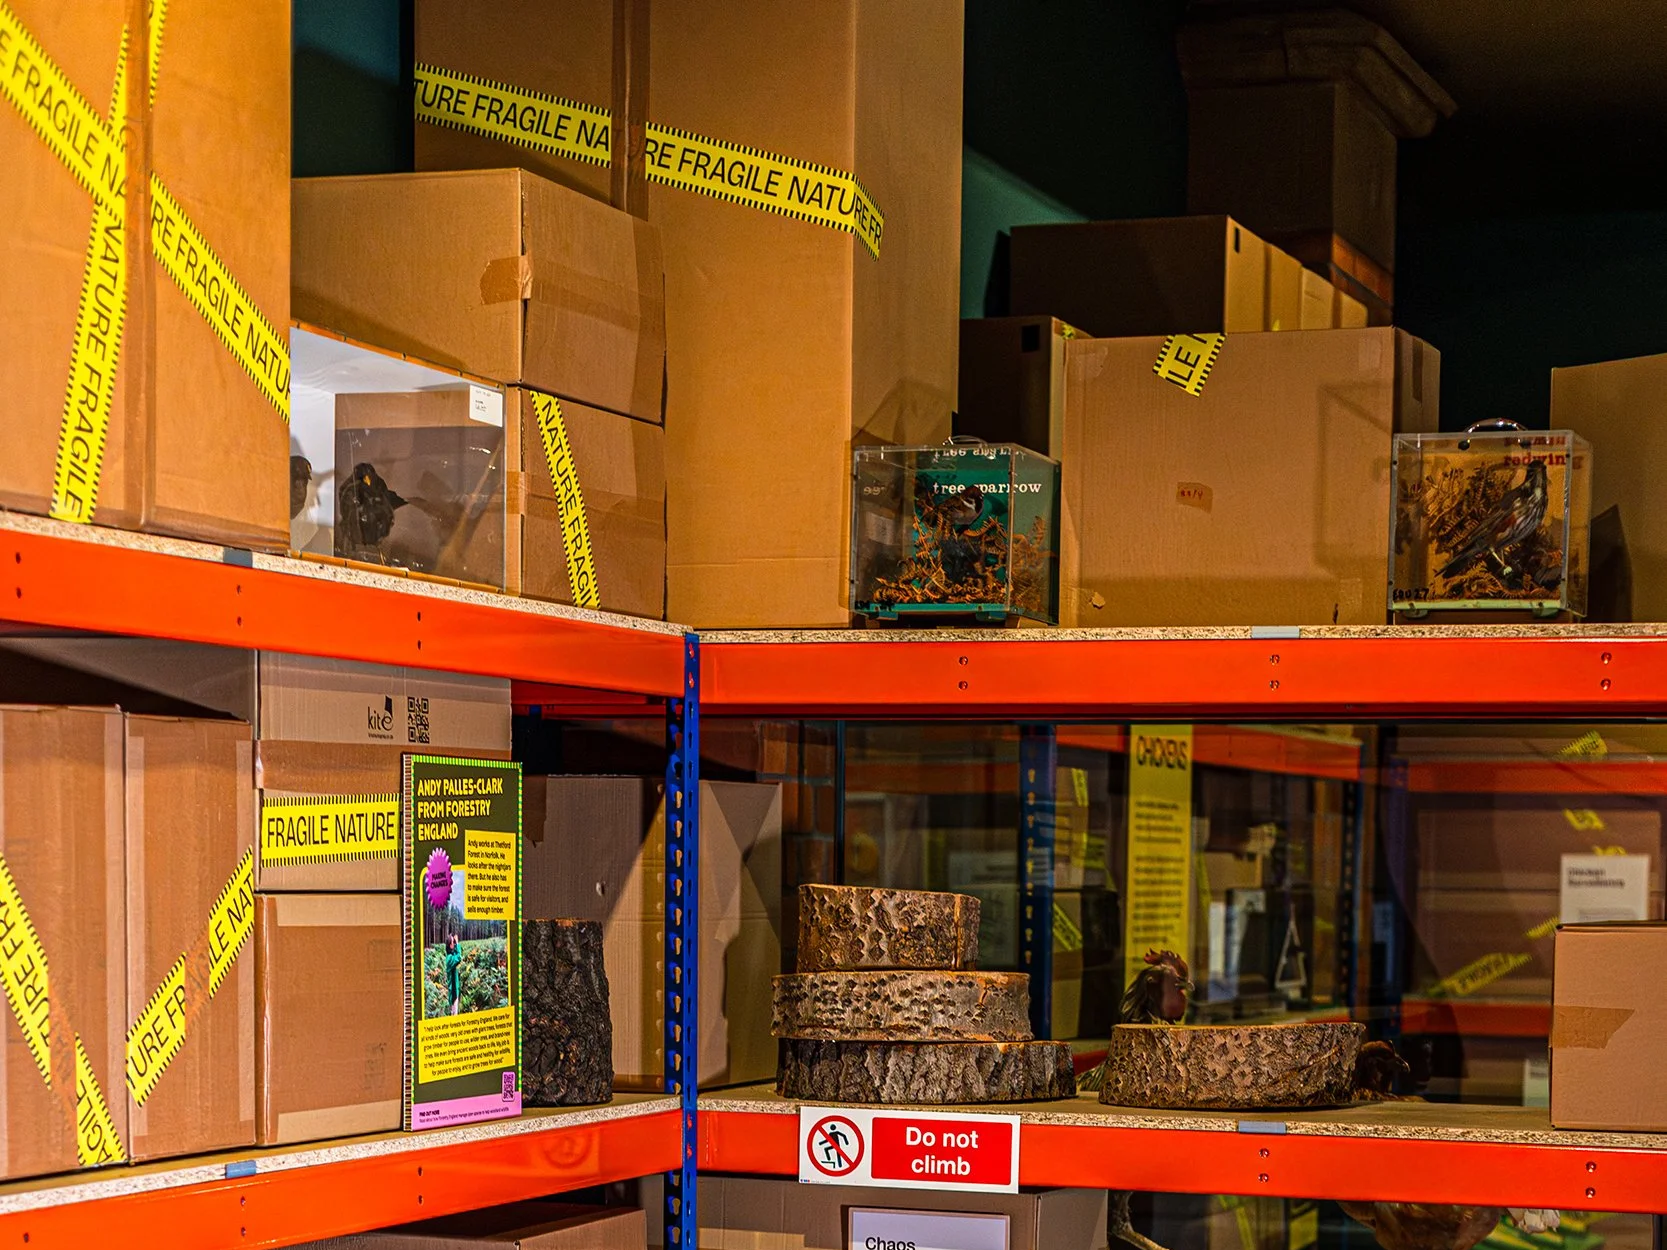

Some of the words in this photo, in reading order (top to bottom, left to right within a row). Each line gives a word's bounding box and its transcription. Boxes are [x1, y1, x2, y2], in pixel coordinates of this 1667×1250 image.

[472, 95, 569, 141] FRAGILE
[677, 147, 783, 198] FRAGILE
[788, 175, 869, 232] NATURE
[12, 51, 98, 170] FRAGILE
[177, 234, 242, 337] FRAGILE
[84, 221, 123, 358] NATURE
[65, 362, 104, 517] FRAGILE
[541, 399, 577, 515] NATURE
[1503, 453, 1584, 470] reding
[933, 482, 966, 495] tree
[974, 482, 1042, 496] parrow
[368, 704, 394, 731] kite
[418, 779, 442, 797] ANDY
[443, 778, 503, 796] PALLES-CLARK
[418, 800, 444, 819] FROM
[446, 800, 491, 818] FORESTRY
[267, 815, 329, 848] FRAGILE
[335, 812, 395, 843] NATURE
[418, 823, 459, 841] ENGLAND
[906, 1127, 936, 1147] Do
[943, 1130, 978, 1149] not
[911, 1155, 971, 1176] climb
